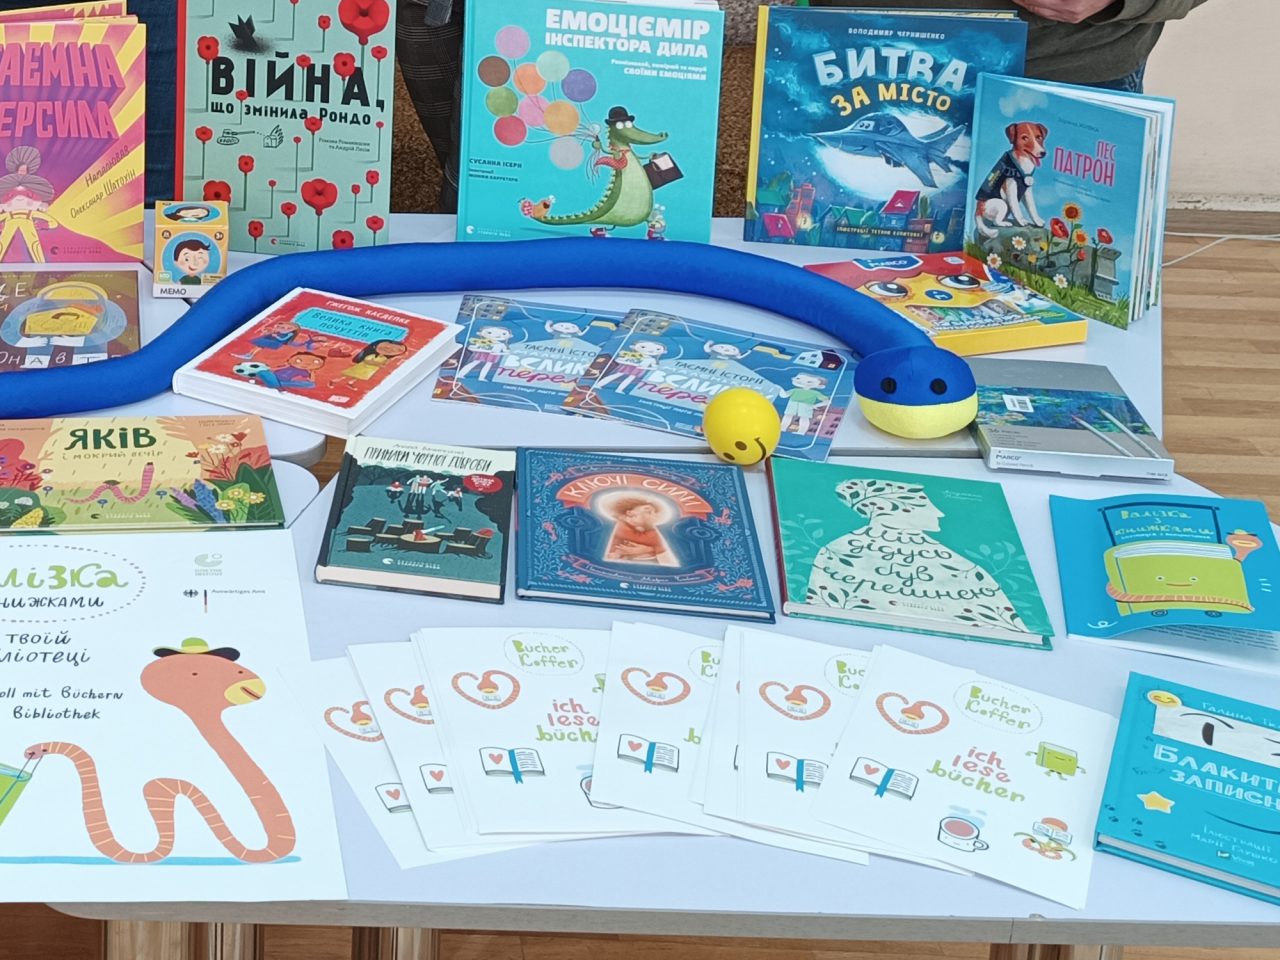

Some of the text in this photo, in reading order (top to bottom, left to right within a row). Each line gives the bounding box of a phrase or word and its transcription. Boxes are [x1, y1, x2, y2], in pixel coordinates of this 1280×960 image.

[546, 8, 711, 41] ЕМОЦІЄМІР
[545, 31, 708, 59] ІНСПЕКТОРА ДИЛА
[211, 51, 384, 112] ВІЙНА,
[812, 46, 968, 92] БИТВА
[830, 82, 952, 117] ЗА МІСТО
[1096, 140, 1117, 162] ПЕС
[85, 144, 130, 188] Намалював
[1053, 147, 1115, 188] ПАТРОН
[312, 312, 393, 336] Велика книга
[319, 322, 370, 338] почуттів
[564, 475, 628, 498] КЛЮЧІ
[847, 537, 953, 564] дідусь
[811, 562, 1003, 601] черешнею
[875, 563, 934, 587] був
[5, 629, 72, 644] твоїй
[23, 685, 53, 699] mit
[60, 685, 124, 702] Büchern
[552, 697, 590, 714] ich
[13, 705, 102, 720] Bibliothek
[547, 712, 600, 727] lese
[952, 754, 1012, 783] lese
[967, 746, 1006, 771] ich
[926, 759, 1025, 802] bücher
